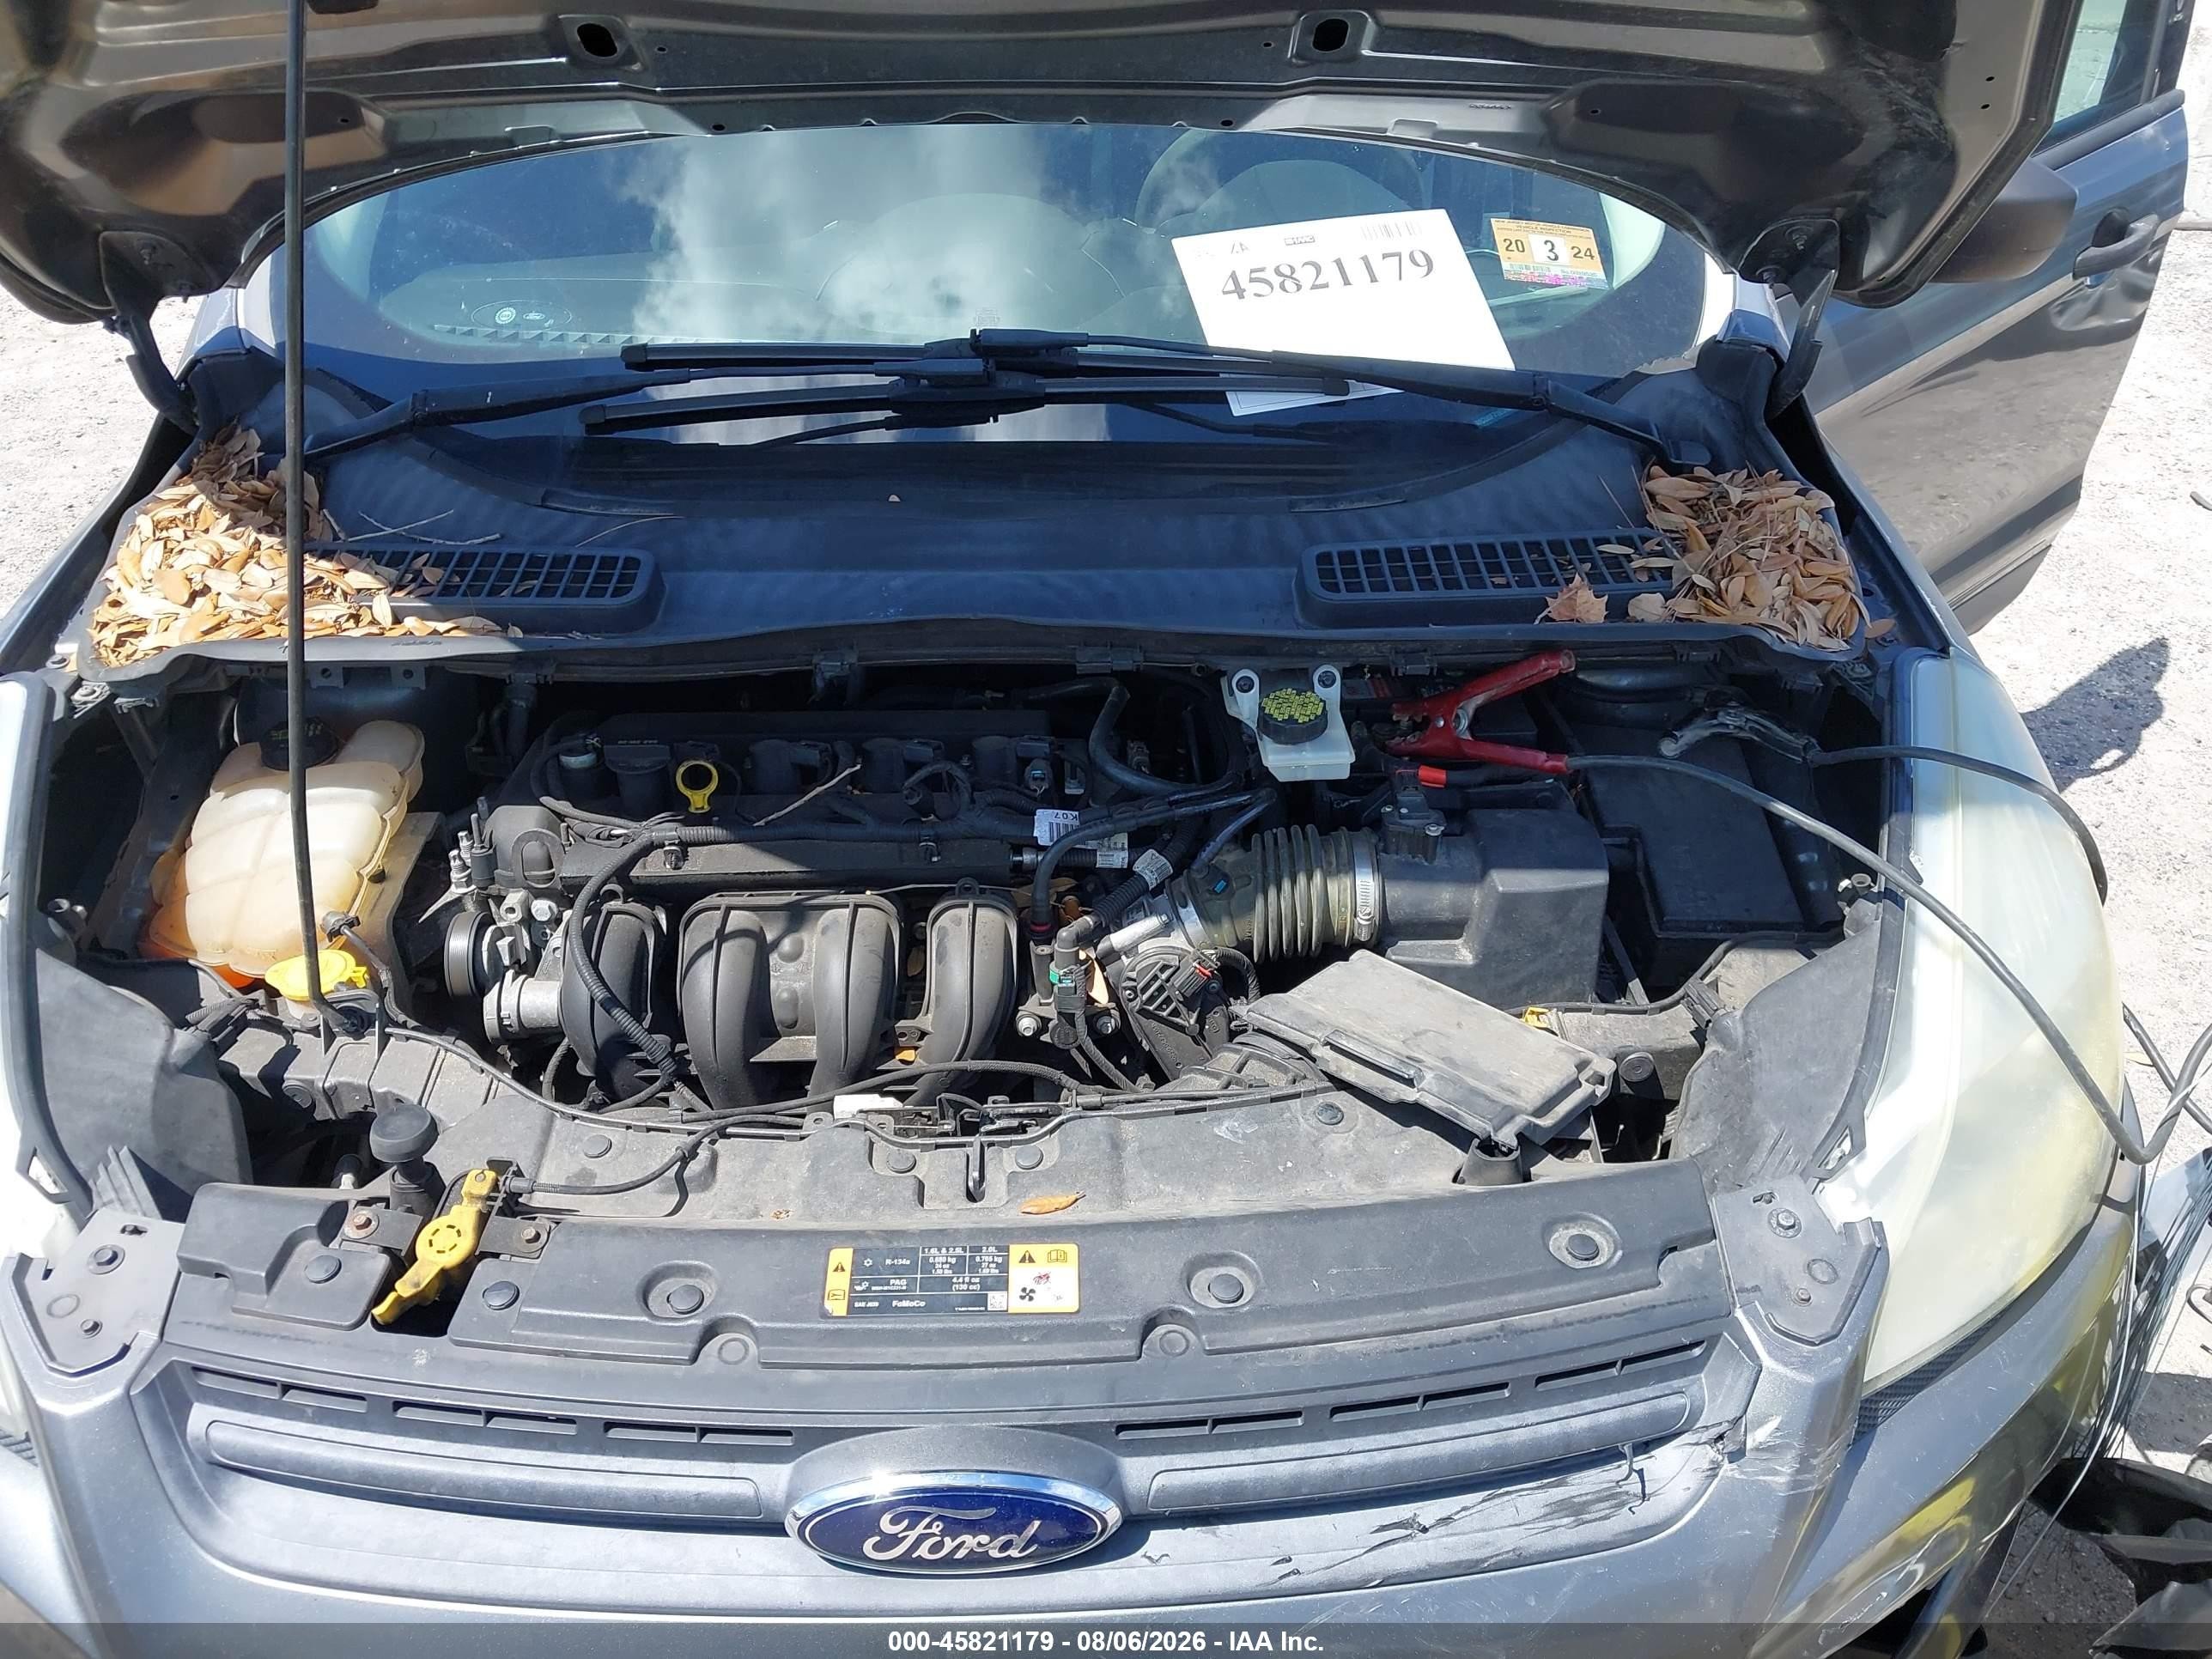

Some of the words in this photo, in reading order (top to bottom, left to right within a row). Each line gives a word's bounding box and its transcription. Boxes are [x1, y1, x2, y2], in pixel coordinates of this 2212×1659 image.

[1503, 238, 1525, 253] 20
[1543, 240, 1559, 262] 3
[1570, 246, 1595, 261] 24
[1221, 249, 1435, 301] 45821179
[1054, 811, 1078, 821] K07
[862, 1505, 1037, 1561] Ford
